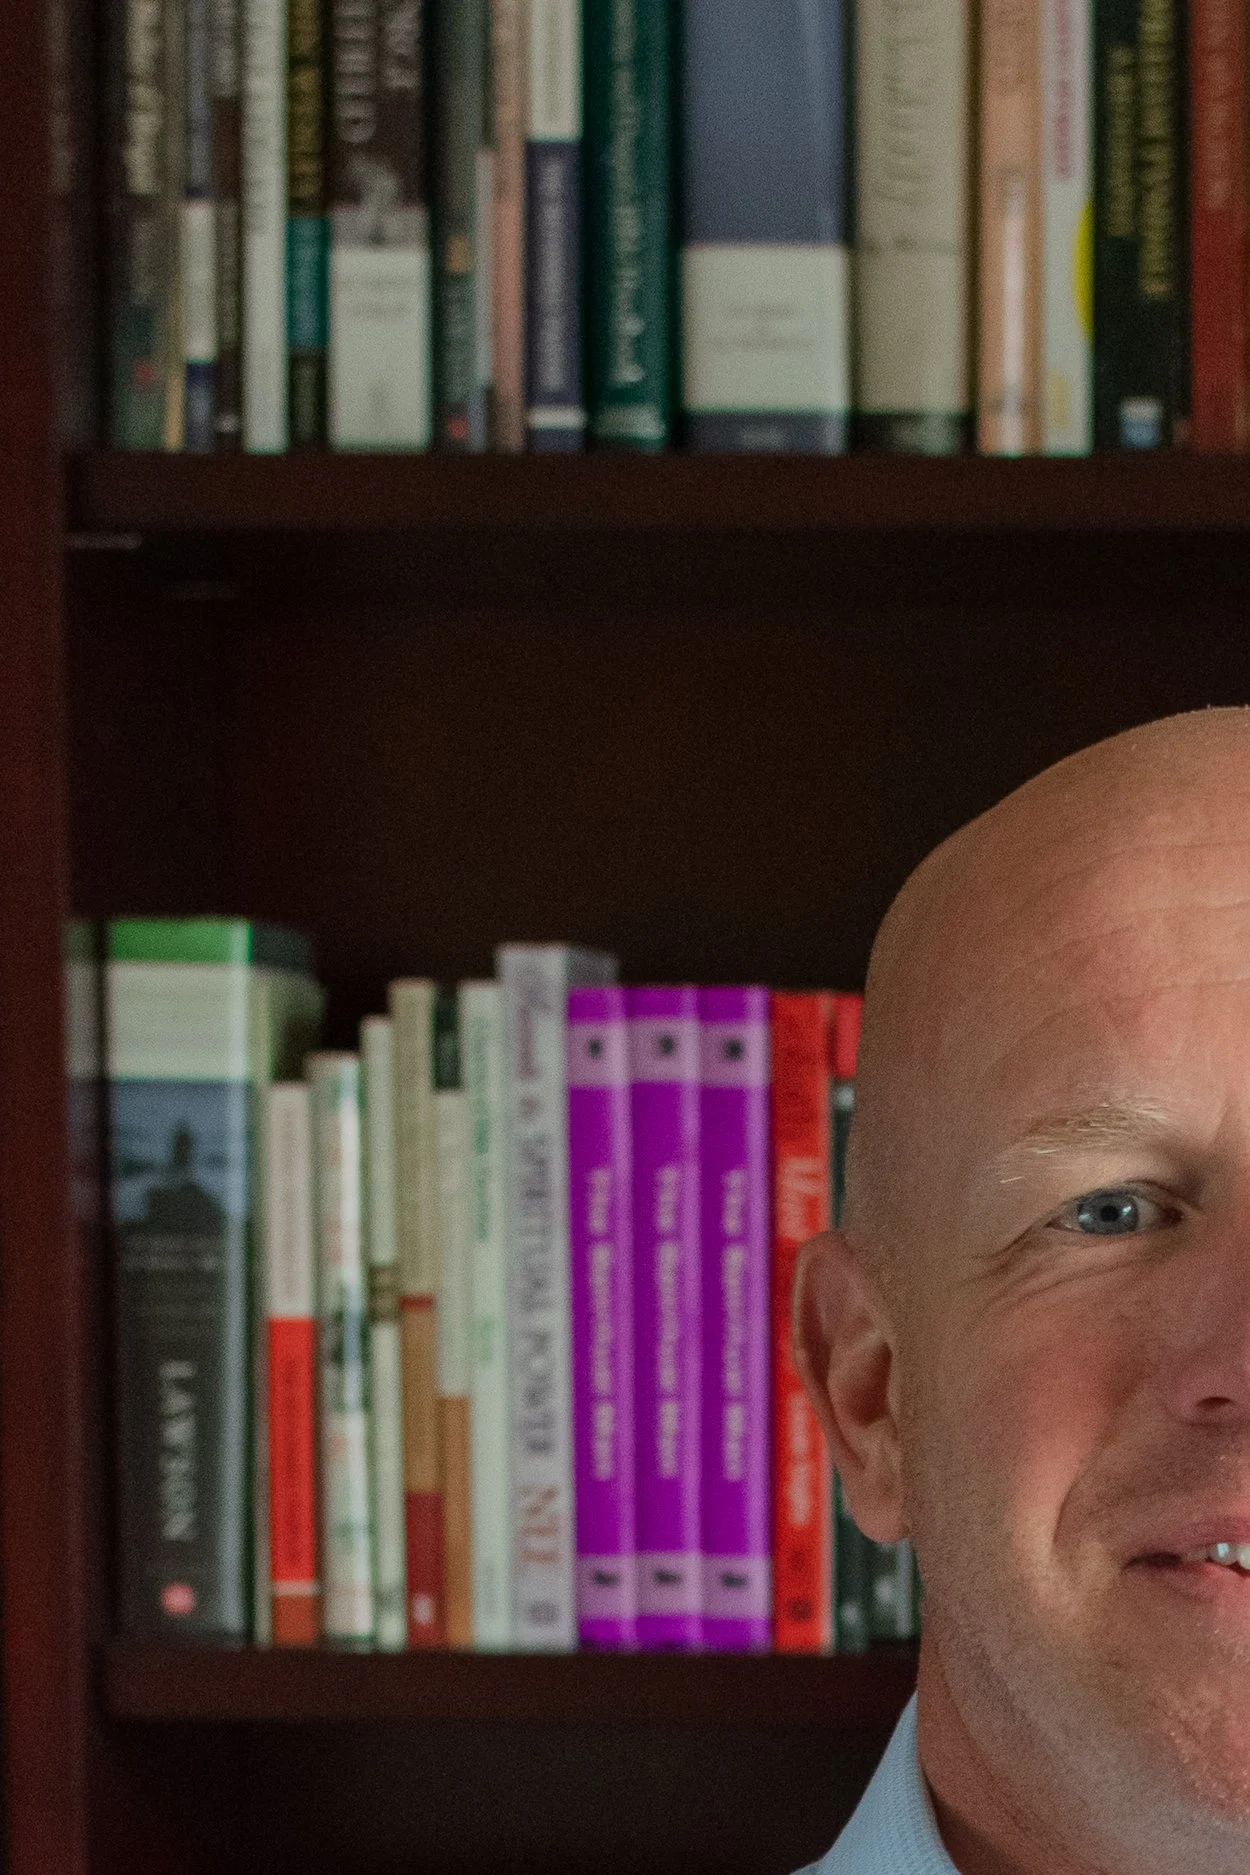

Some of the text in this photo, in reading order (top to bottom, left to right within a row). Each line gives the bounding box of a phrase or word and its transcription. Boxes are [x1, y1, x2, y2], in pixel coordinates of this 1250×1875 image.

[519, 1134, 555, 1311] SPIRITUAL
[160, 1360, 196, 1541] LAWSON
[517, 1328, 556, 1458] POWER
